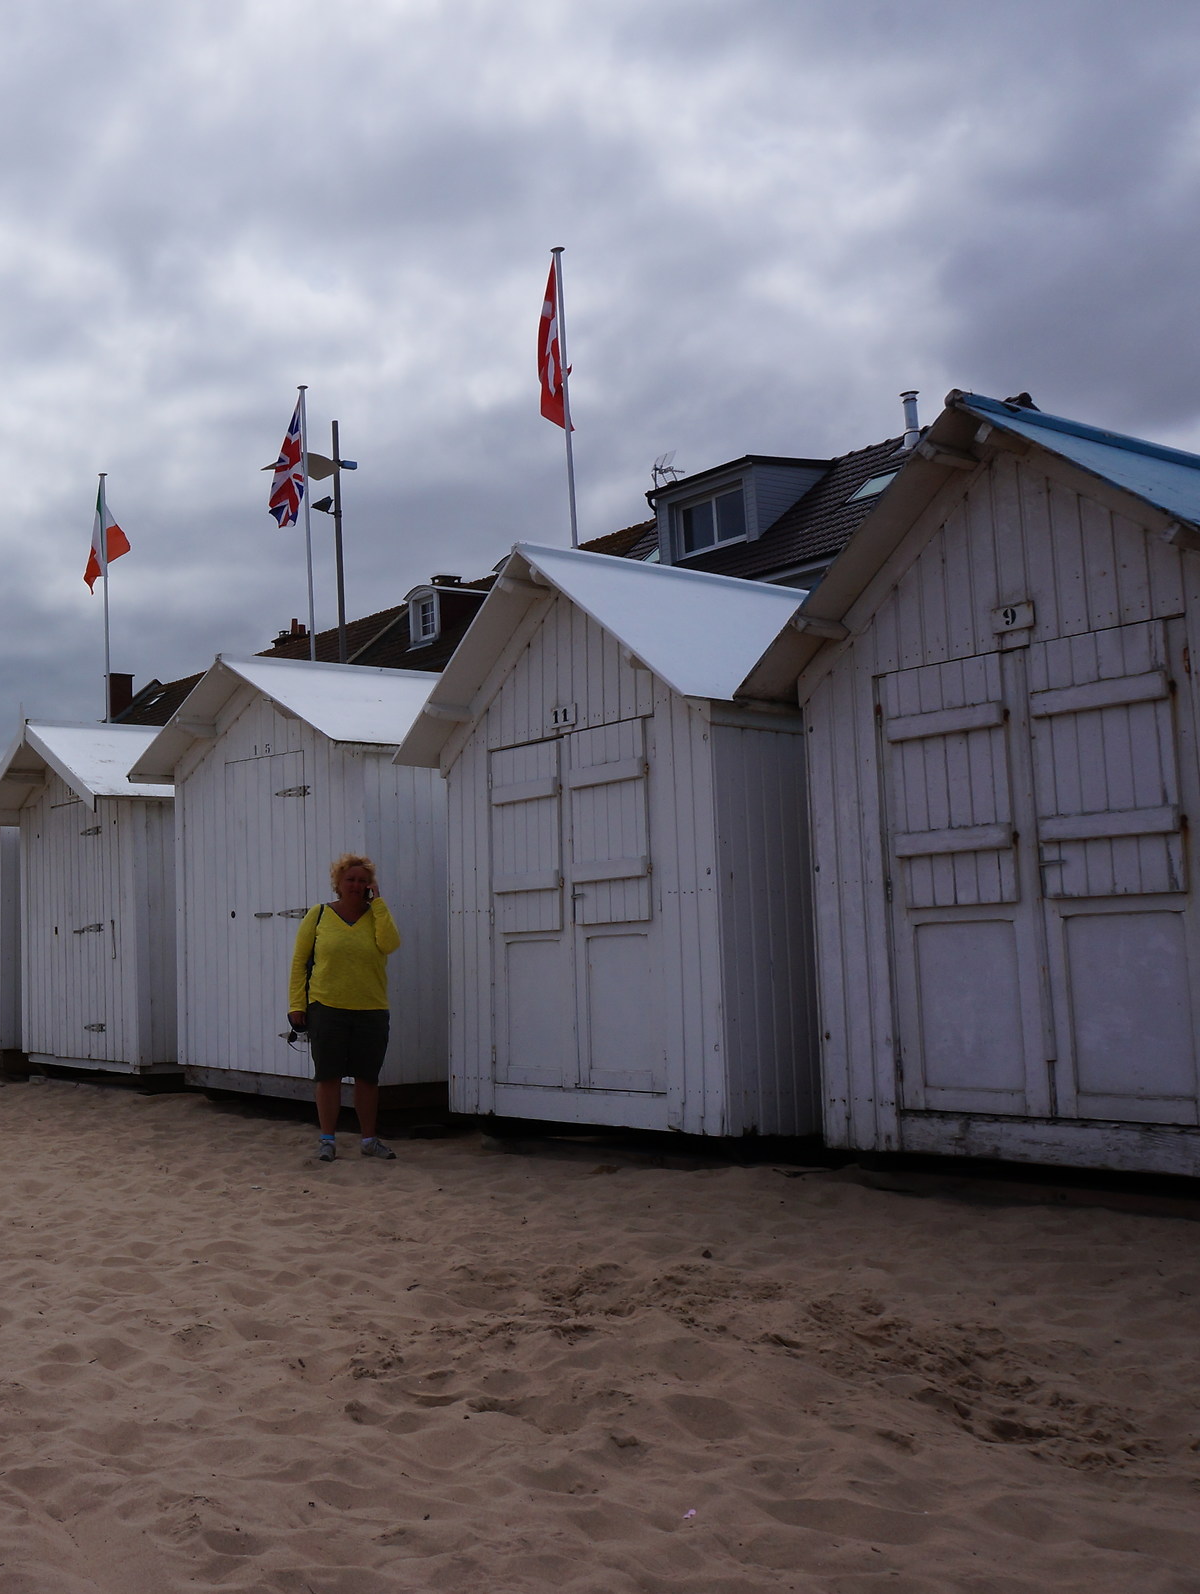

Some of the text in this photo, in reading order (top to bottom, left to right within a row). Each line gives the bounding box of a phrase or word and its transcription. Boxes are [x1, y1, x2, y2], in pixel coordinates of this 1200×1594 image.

[1003, 607, 1017, 626] 9
[552, 708, 569, 725] 11
[254, 743, 271, 756] 15
